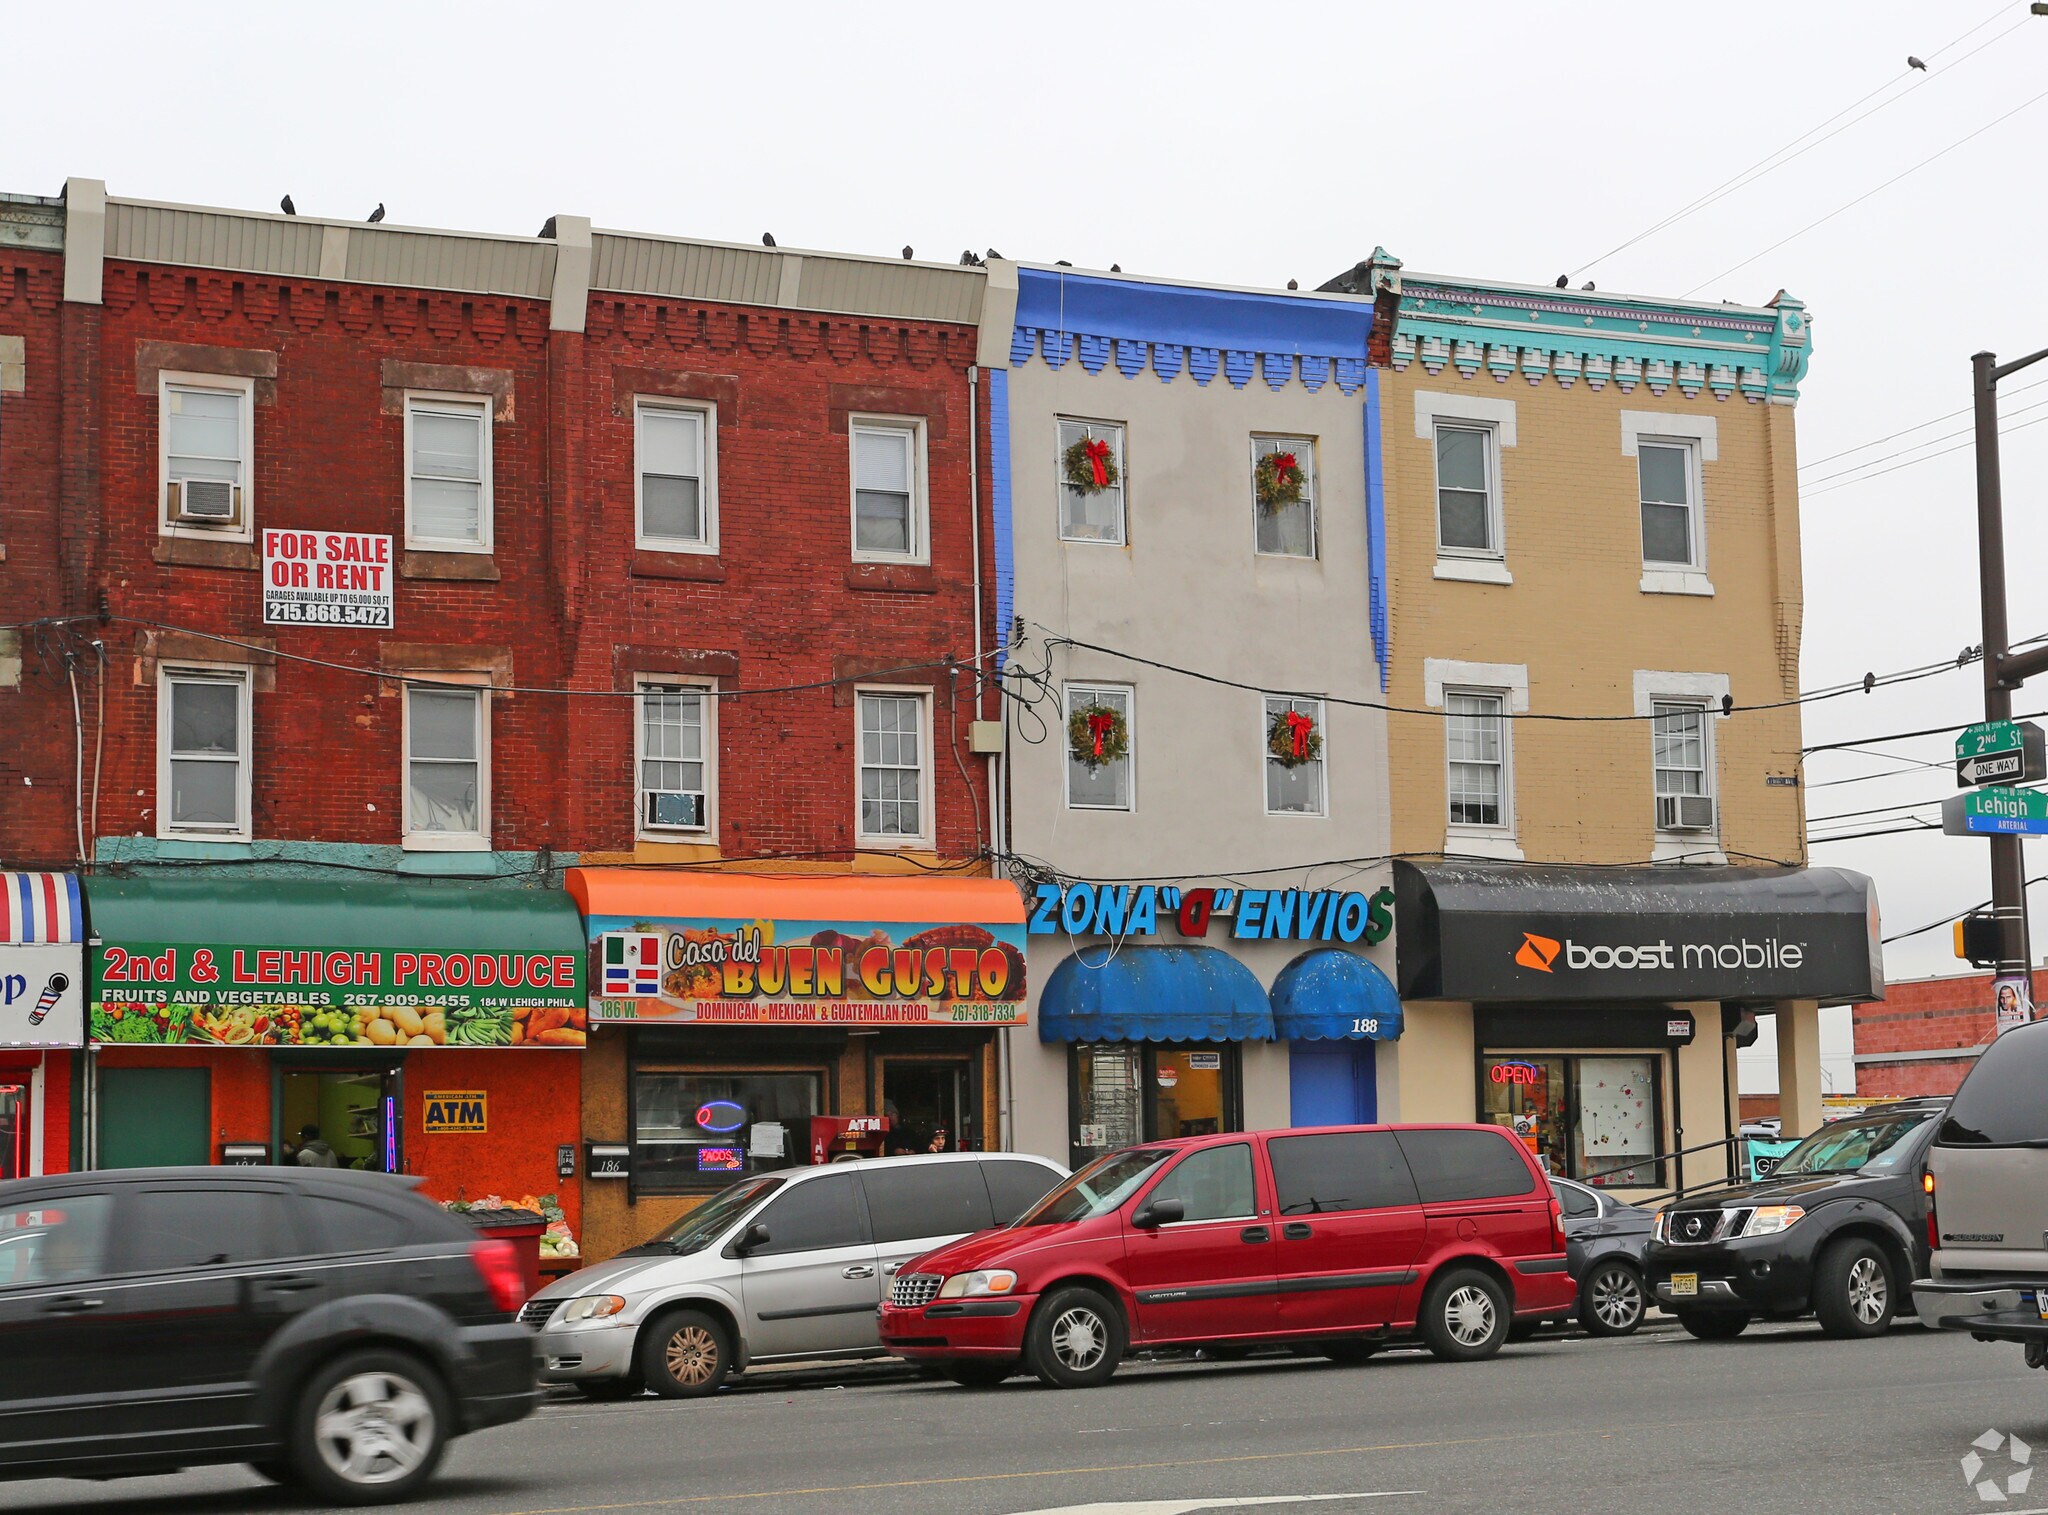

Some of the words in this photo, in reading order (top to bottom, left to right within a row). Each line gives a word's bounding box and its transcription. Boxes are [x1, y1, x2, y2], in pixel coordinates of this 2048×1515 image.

[266, 532, 318, 560] FOR
[325, 535, 389, 563] SALE
[271, 561, 309, 588] OR
[317, 563, 385, 591] RENT
[266, 590, 295, 601] GARAGES
[296, 591, 328, 602] AVAILABLE
[329, 593, 338, 603] UP
[340, 594, 347, 604] TO
[269, 603, 386, 624] 215.868.5472
[2010, 730, 2022, 746] St
[1976, 762, 1994, 776] ONE
[1996, 758, 2015, 773] WAY
[2009, 788, 2015, 796] W
[1976, 796, 2028, 818] Lehigh
[1968, 817, 1974, 829] E
[1998, 820, 2028, 831] ARTERIAL
[1028, 882, 1156, 936] ZONA
[666, 933, 728, 971] Casa
[732, 927, 761, 964] del
[1566, 939, 1675, 970] boost
[1682, 938, 1803, 969] mobile
[102, 947, 177, 984] 2nd
[189, 948, 220, 984] &
[233, 949, 381, 986] LEHIGH
[393, 952, 576, 989] PRODUCE
[721, 945, 845, 998] BUEN
[859, 945, 1010, 999] GUSTO
[101, 988, 168, 1003] FRUITS
[172, 990, 211, 1003] AND
[216, 991, 331, 1005] VEGETABLES
[343, 994, 471, 1007] 267-909-9455
[480, 998, 497, 1007] 184
[499, 998, 509, 1007] W
[510, 998, 545, 1008] LEHIGH
[547, 998, 575, 1008] PHILA
[599, 1001, 621, 1019] 186
[623, 1001, 639, 1019] W.
[696, 1002, 759, 1020] DOMINICAN
[768, 1003, 816, 1021] MEXICAN
[820, 1008, 829, 1020] &
[831, 1004, 899, 1021] GUATEMALAN
[901, 1004, 929, 1021] FOOD
[951, 1004, 1016, 1021] 267-318-7334
[1351, 1018, 1378, 1033] 188
[1491, 1065, 1535, 1085] OPEN
[425, 1102, 485, 1123] ATM
[848, 1118, 881, 1131] ATM
[701, 1150, 733, 1161] TACOS
[600, 1160, 620, 1172] 186
[1953, 1234, 2004, 1242] SUBURBAN
